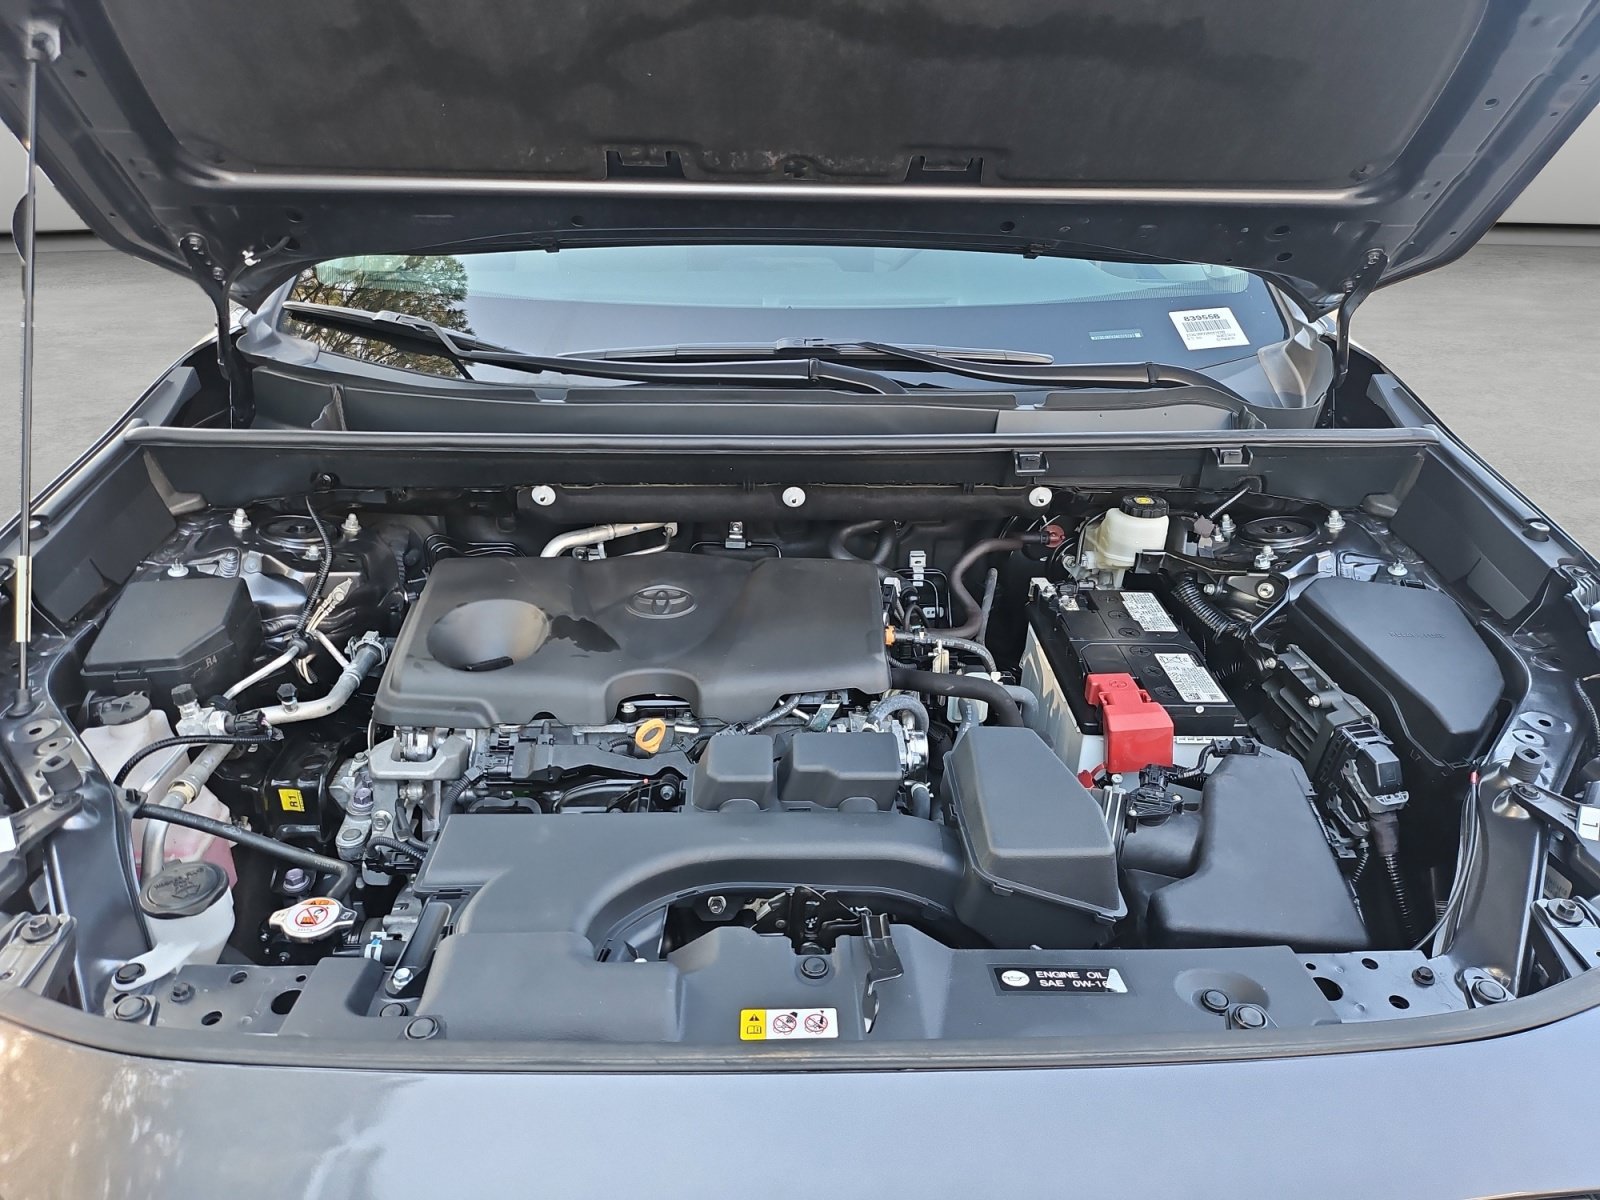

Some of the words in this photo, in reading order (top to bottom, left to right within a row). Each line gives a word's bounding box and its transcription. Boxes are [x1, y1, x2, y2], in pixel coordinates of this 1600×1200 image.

[288, 795, 298, 807] R1
[1035, 971, 1080, 979] ENGINE
[1086, 971, 1108, 979] OIL
[1039, 979, 1065, 987] SAE
